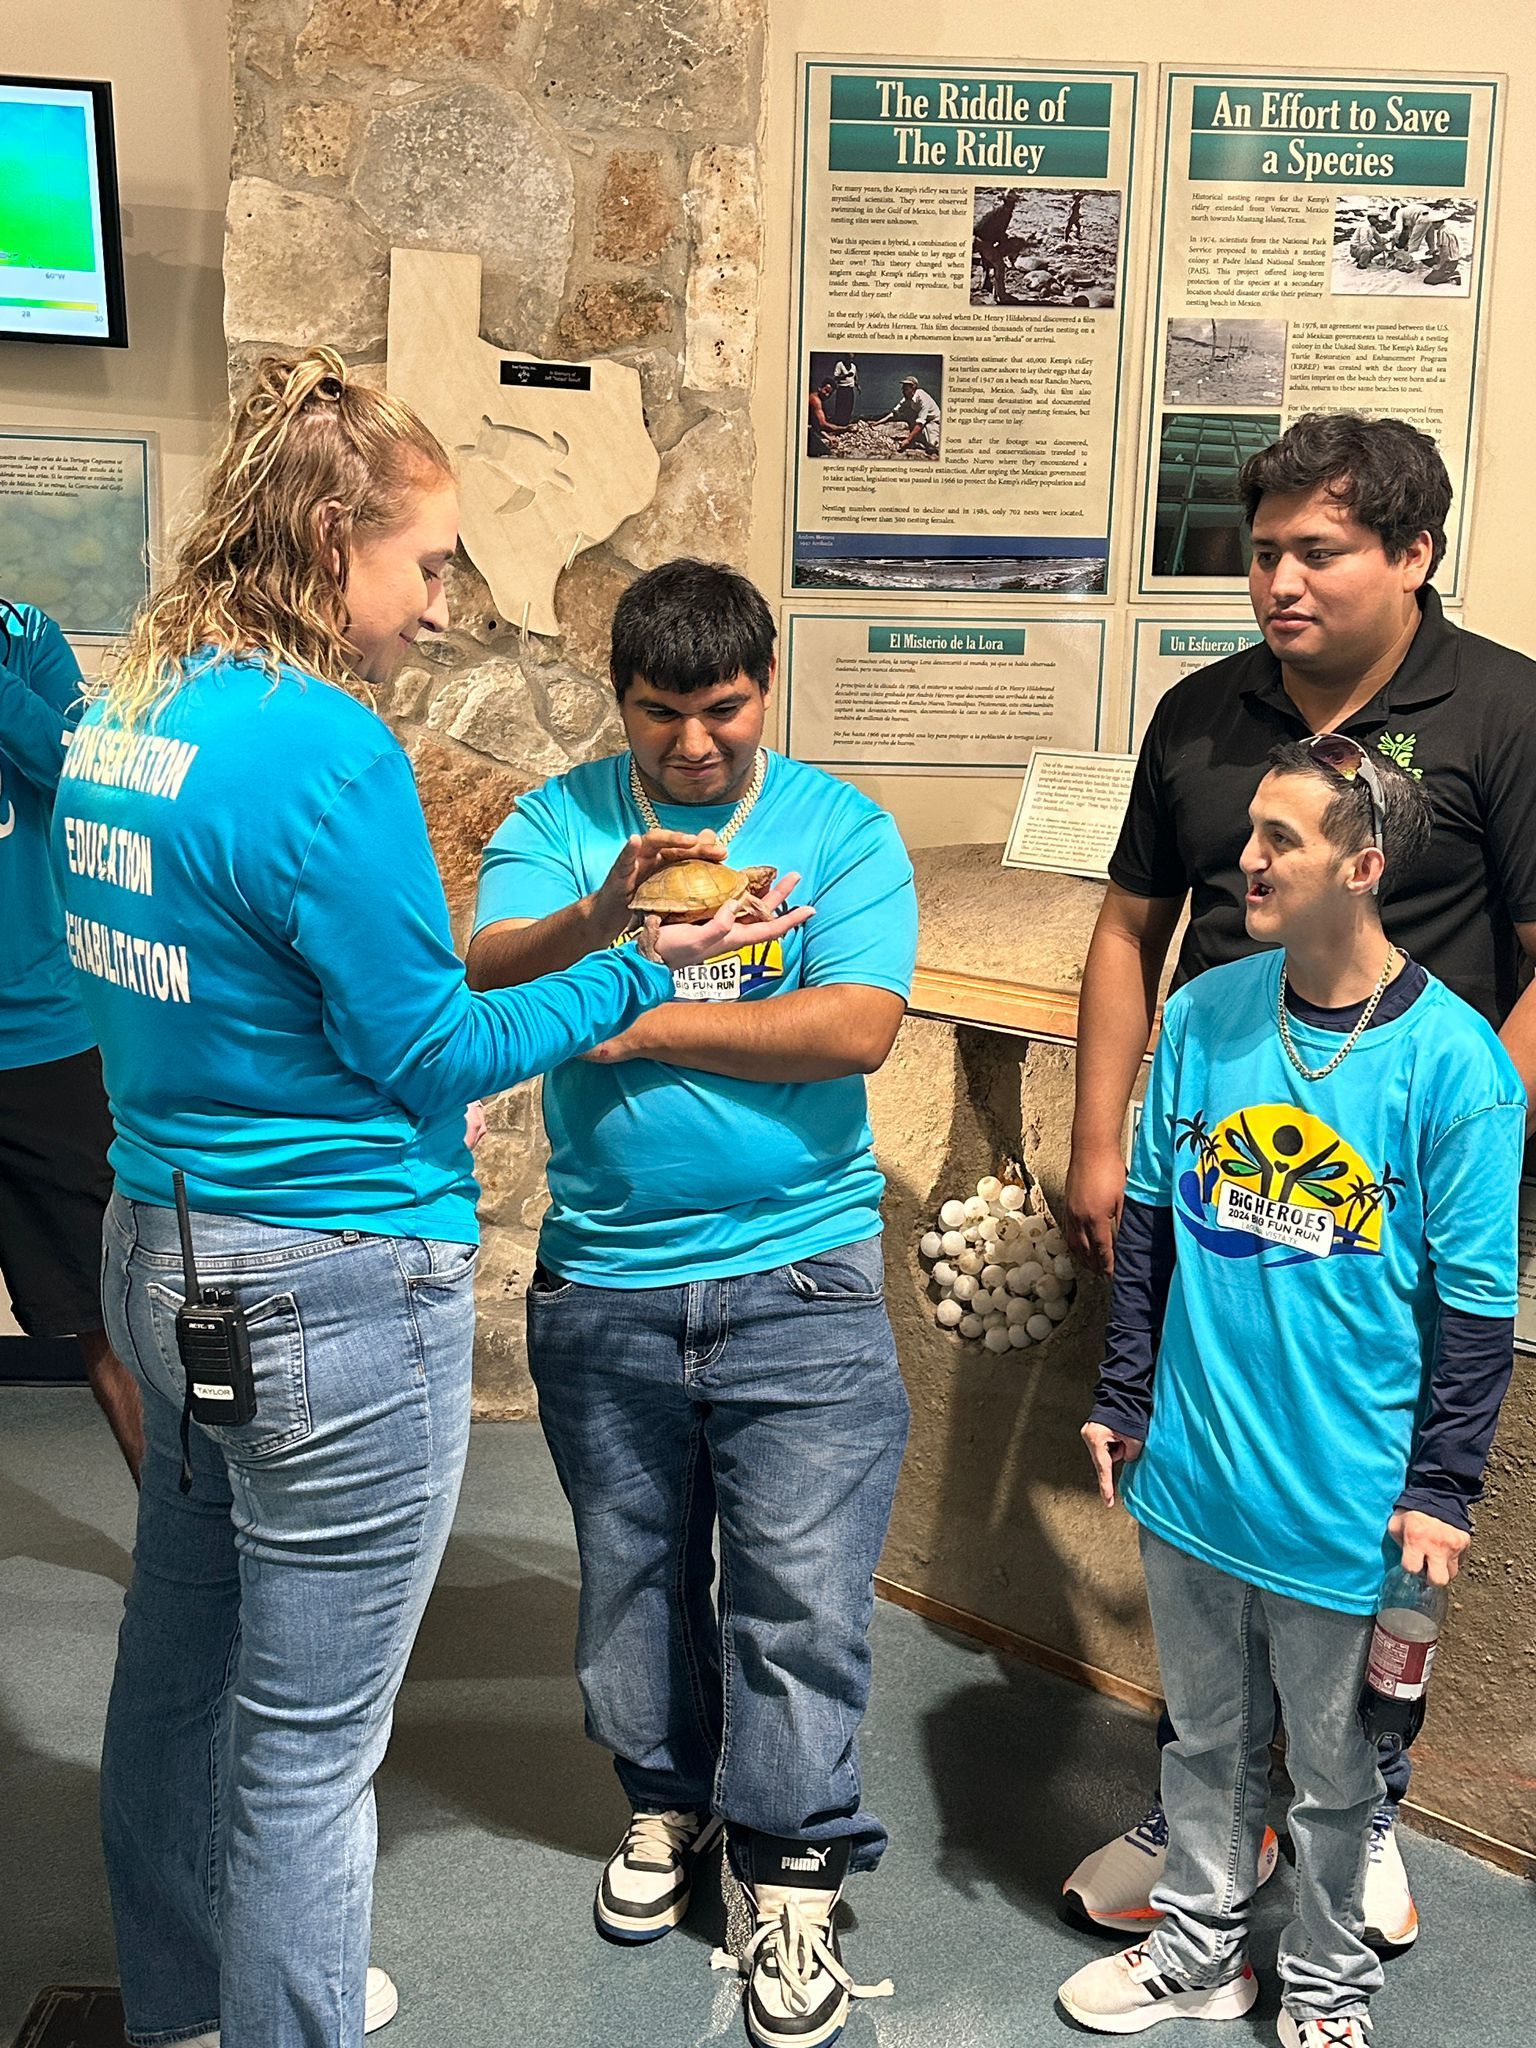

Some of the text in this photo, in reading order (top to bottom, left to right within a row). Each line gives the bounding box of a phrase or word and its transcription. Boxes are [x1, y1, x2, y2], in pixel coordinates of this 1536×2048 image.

[876, 80, 1071, 123] The Riddle of
[1211, 91, 1451, 133] An Effort to Save
[893, 127, 1045, 174] The Ridley
[1262, 138, 1395, 181] a Species
[890, 633, 1004, 651] El Misterio de la Lora
[1170, 636, 1186, 652] Un
[1188, 636, 1235, 652] Esfuerzo
[64, 816, 153, 896] EDUCATION
[65, 910, 192, 1004] EHABILITATION
[678, 962, 736, 981] HEROES
[693, 981, 713, 990] FUN
[717, 980, 735, 990] RUN
[1228, 1208, 1321, 1243] 2024 BIG FUN RUN
[1254, 1197, 1328, 1232] HEROES
[197, 1387, 231, 1396] TAYLOR
[781, 1857, 820, 1872] PUMA
